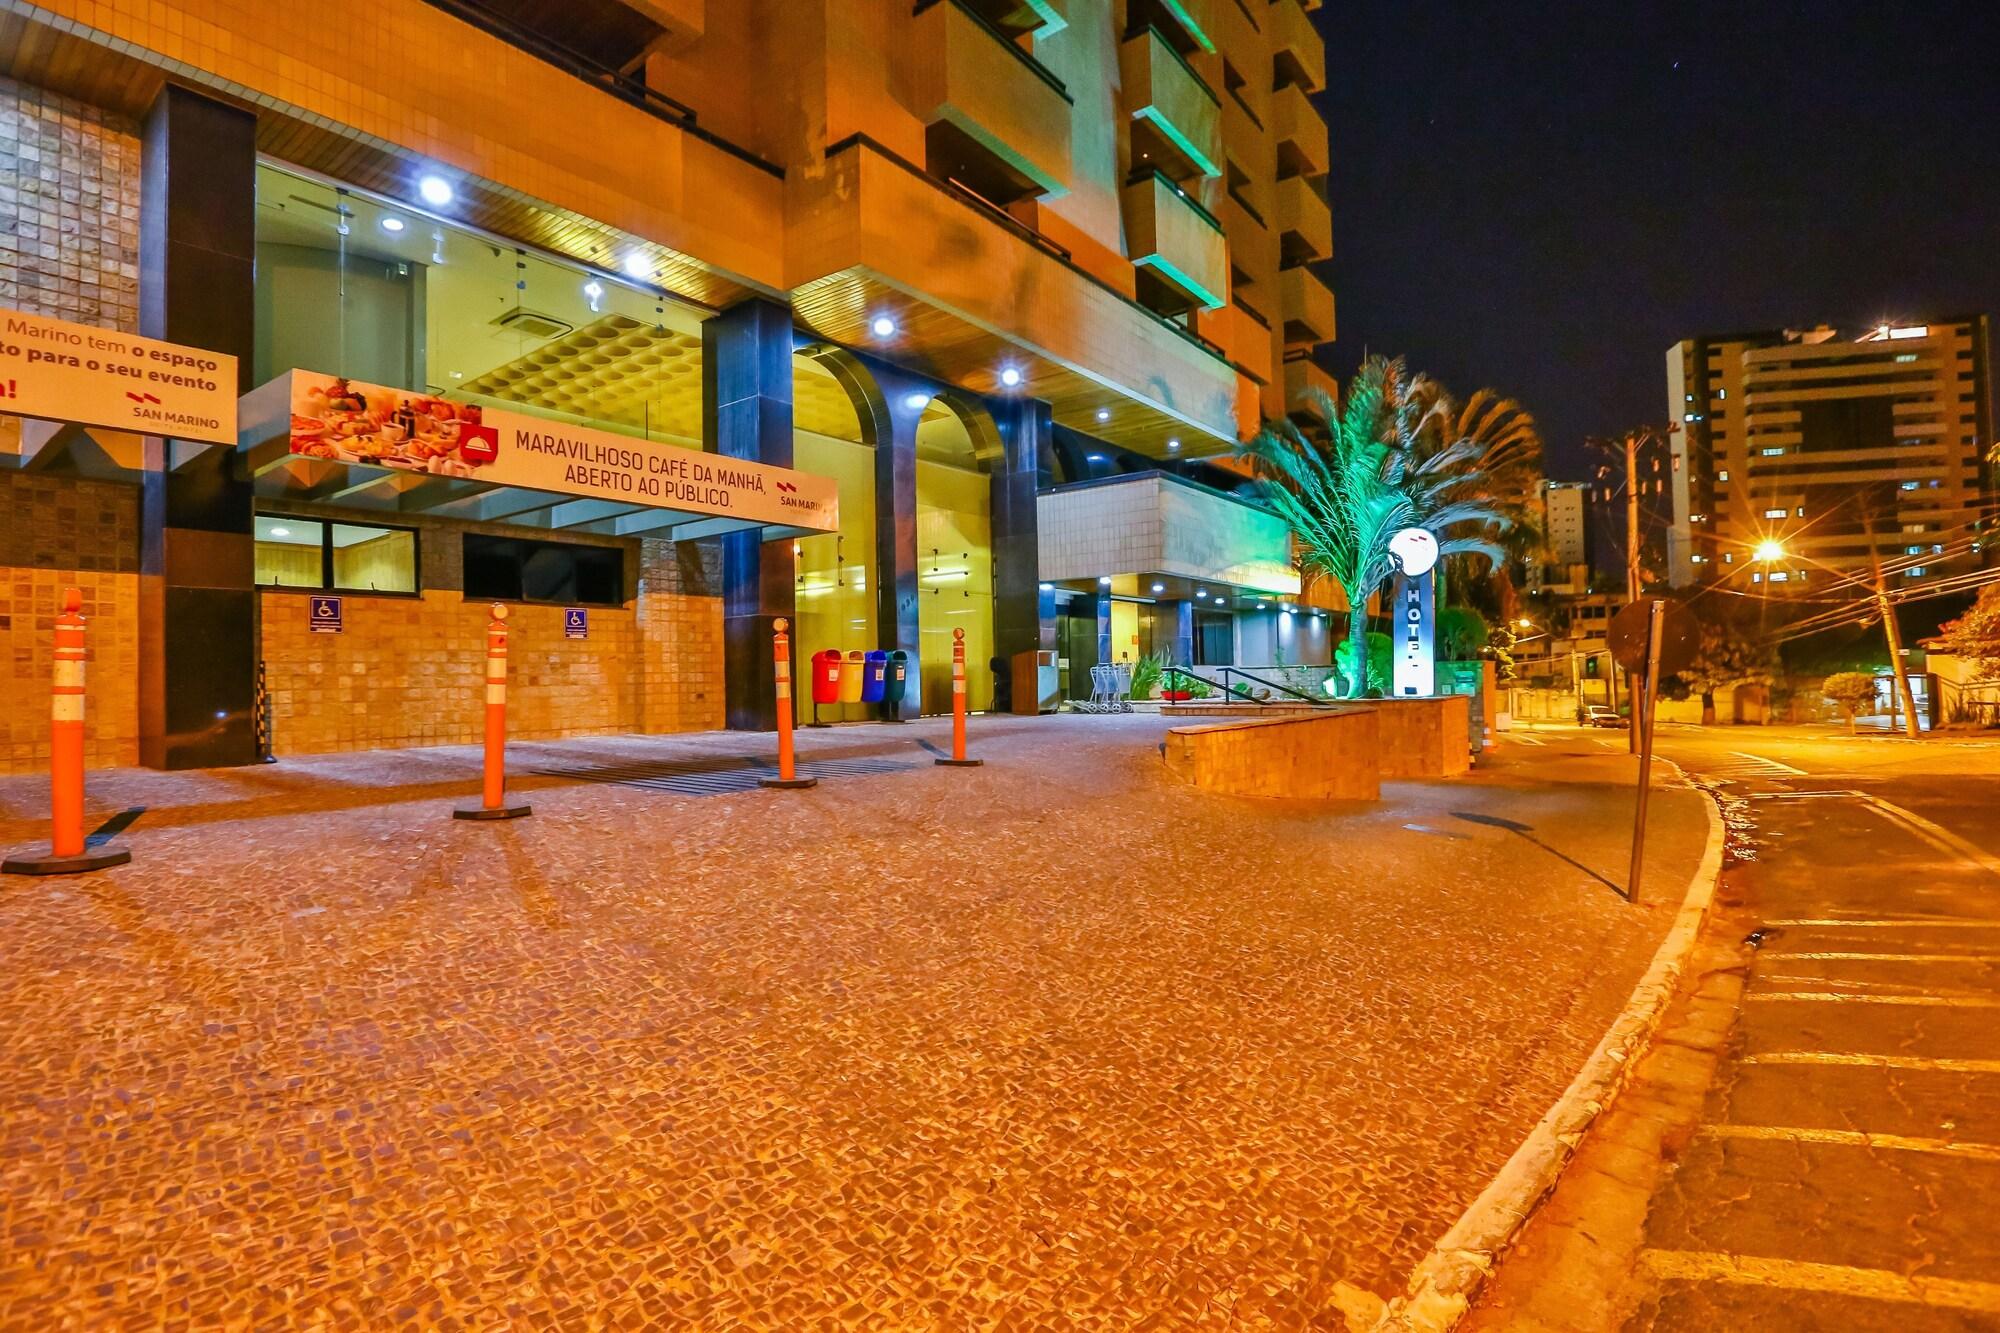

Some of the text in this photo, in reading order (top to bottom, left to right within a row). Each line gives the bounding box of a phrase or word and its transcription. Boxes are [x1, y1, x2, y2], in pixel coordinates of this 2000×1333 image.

[7, 318, 217, 372] Marino tem o espaço
[27, 348, 80, 367] para
[86, 360, 100, 371] o
[105, 362, 142, 378] seu
[148, 370, 217, 391] evento
[133, 407, 161, 420] SAN
[164, 412, 219, 429] MARINO
[516, 429, 767, 495] MARAVILHOSO CAFÉ DA MANHÃ,
[565, 464, 733, 508] ABERTO AO PÚBLICO.
[780, 496, 797, 507] SAN
[1407, 589, 1421, 673] HOTE
